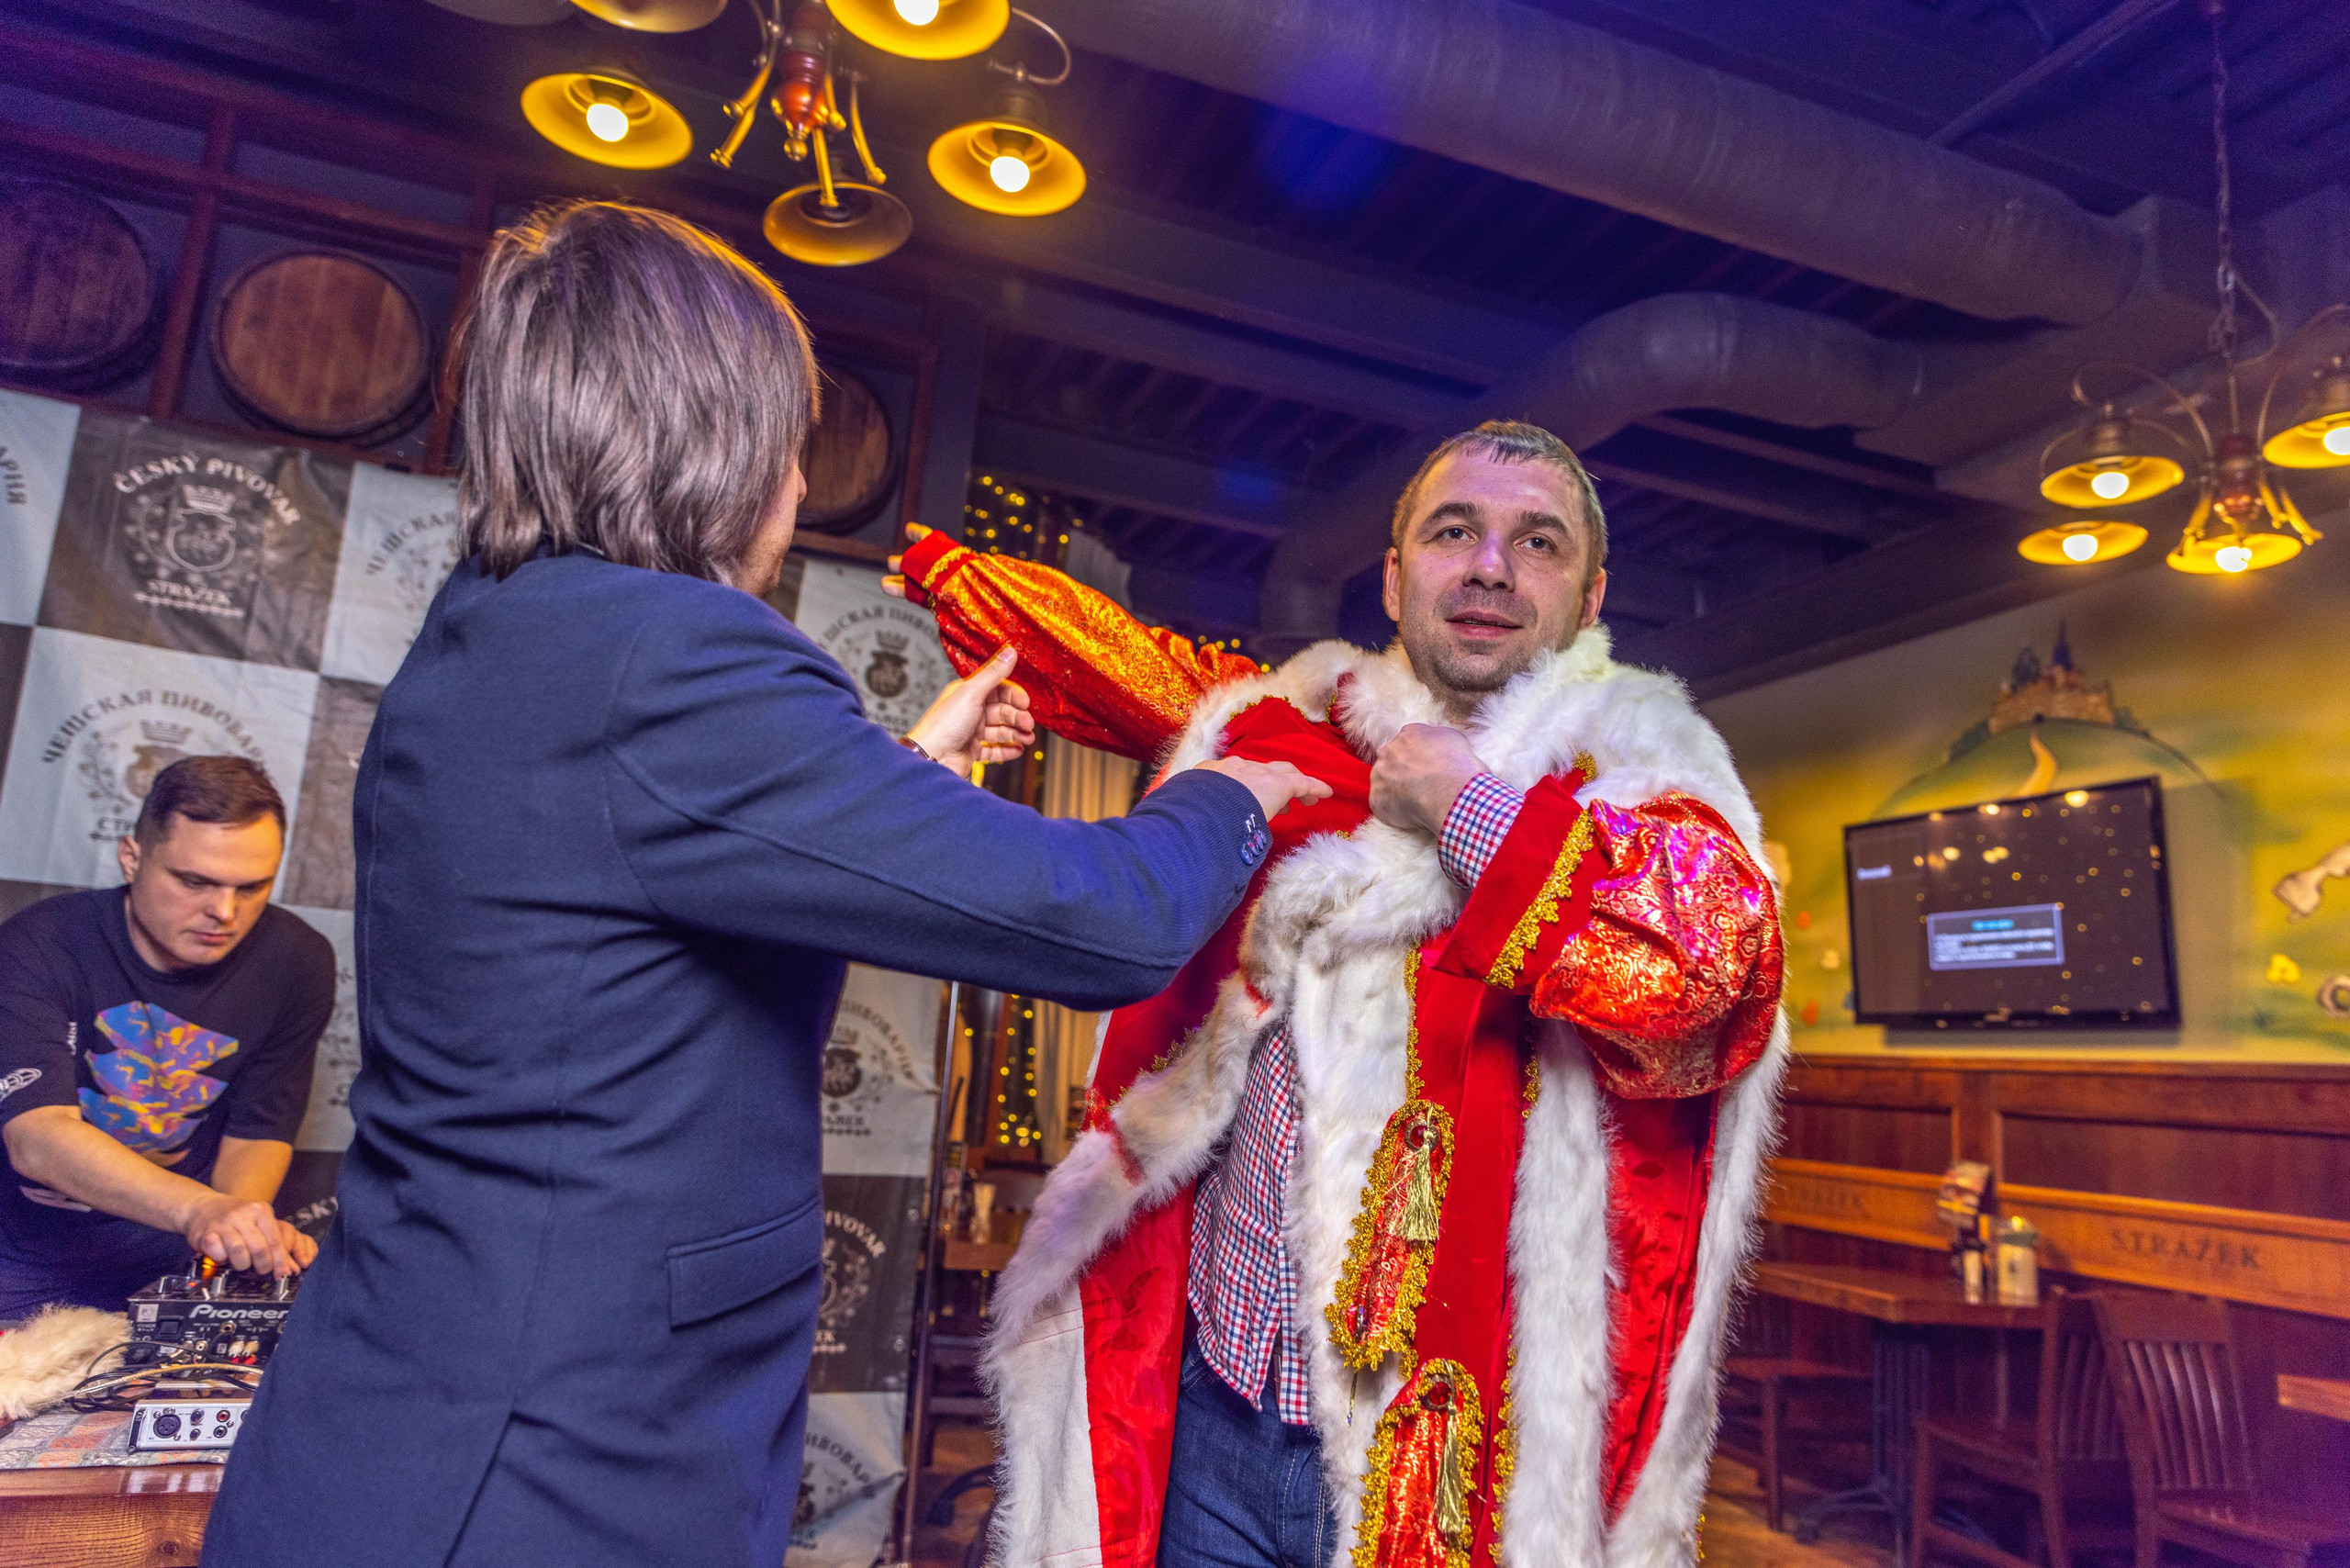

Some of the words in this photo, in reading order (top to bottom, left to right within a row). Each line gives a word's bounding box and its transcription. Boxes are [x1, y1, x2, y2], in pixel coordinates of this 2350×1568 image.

[113, 451, 199, 494] ČESKÝ
[206, 457, 301, 526] PIVOVAR
[42, 689, 152, 764] ЧЕШСКАЯ
[2111, 1228, 2260, 1271] STRAŽEK
[189, 1304, 289, 1320] Pioneer
